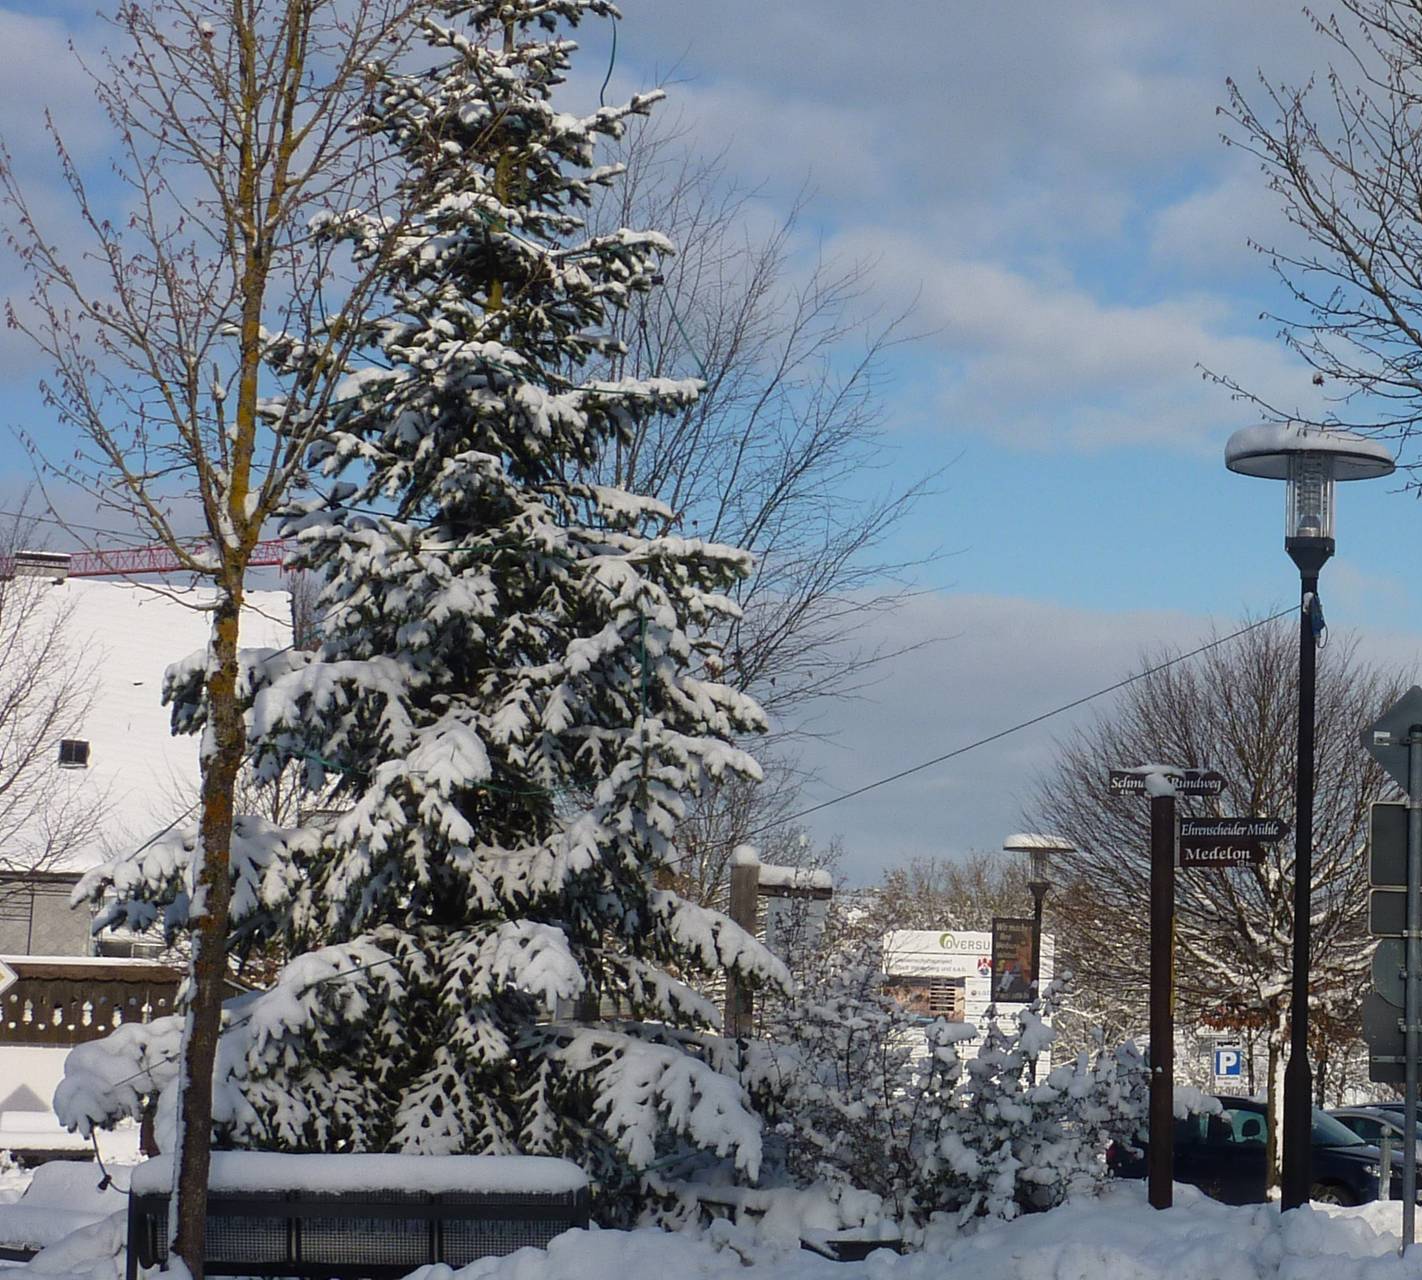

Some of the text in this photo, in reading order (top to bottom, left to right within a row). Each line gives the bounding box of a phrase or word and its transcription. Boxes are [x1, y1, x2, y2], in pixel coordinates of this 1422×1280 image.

[1171, 775, 1222, 793] Rundweg
[1181, 821, 1279, 836] Ehrenscheider Mühle
[1185, 846, 1251, 860] Medelon
[945, 940, 990, 950] OVERSU
[1219, 1052, 1237, 1074] P
